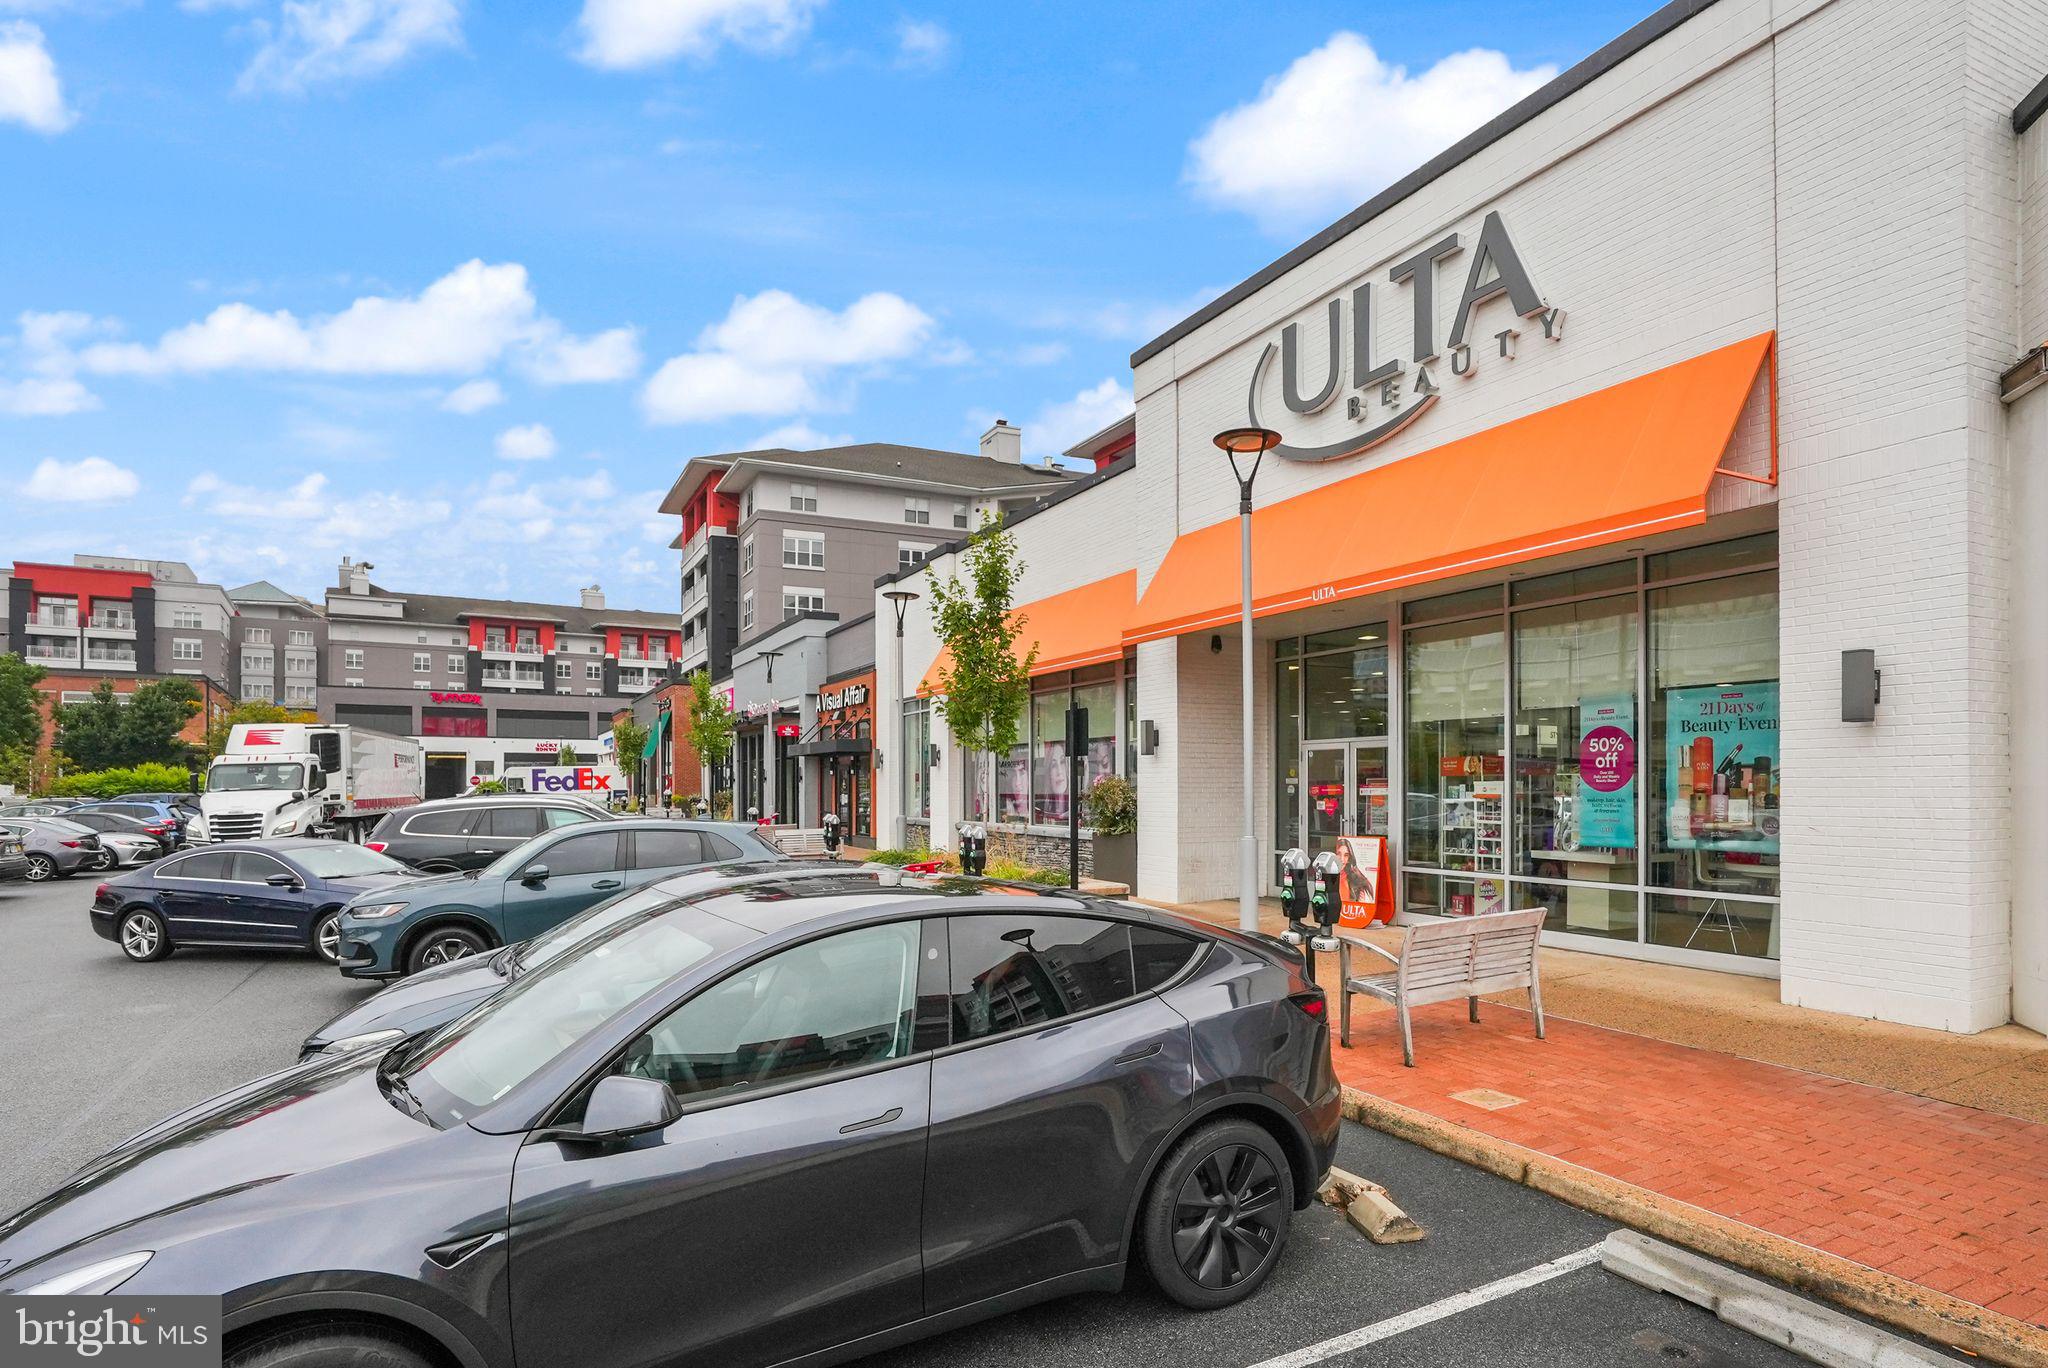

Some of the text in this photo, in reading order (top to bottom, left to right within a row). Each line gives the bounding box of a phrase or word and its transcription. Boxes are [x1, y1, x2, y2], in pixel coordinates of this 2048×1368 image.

[1282, 210, 1549, 414] ULTA
[1347, 308, 1567, 423] BEAUTY
[1312, 586, 1336, 601] ULTA
[821, 692, 843, 712] Visual
[843, 684, 866, 708] Affair
[1700, 701, 1767, 718] 21 Days of
[1681, 716, 1778, 734] Beauty Even
[1589, 737, 1624, 752] 50%
[1595, 752, 1618, 768] off
[532, 768, 611, 792] FedEx
[1343, 904, 1366, 917] ULTA
